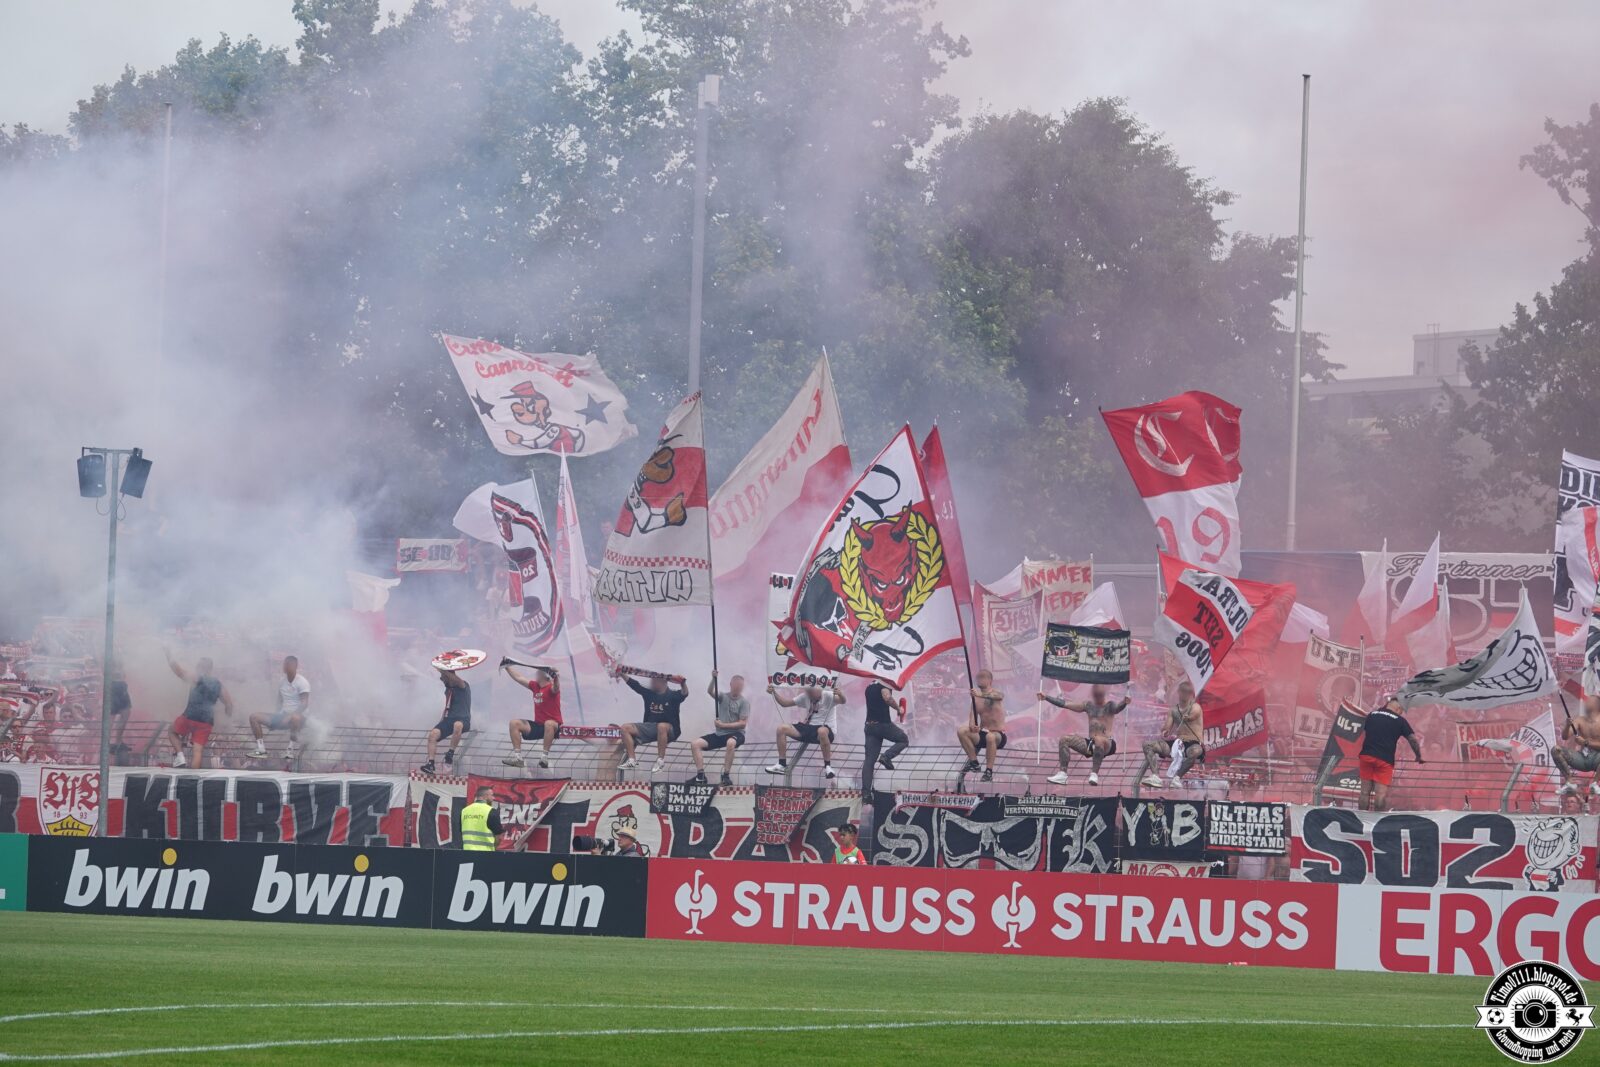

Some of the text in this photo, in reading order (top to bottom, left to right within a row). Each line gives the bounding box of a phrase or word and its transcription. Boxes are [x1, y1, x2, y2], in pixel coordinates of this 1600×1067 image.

[1023, 566, 1091, 592] IMMER
[1046, 658, 1097, 673] SCHWABEN
[1203, 707, 1265, 747] ULTRAS
[669, 785, 714, 795] DU BIST
[765, 788, 813, 799] JEDER
[53, 811, 88, 821] 18 93
[122, 773, 395, 848] KURVE
[667, 804, 685, 813] BEI
[1053, 807, 1078, 816] ULTRAS
[1210, 804, 1284, 824] ULTRAS
[1210, 820, 1284, 837] BEDEUTET
[1209, 833, 1285, 849] WIDERSTAND
[63, 847, 211, 911] bwin
[251, 854, 404, 919] bwin
[447, 862, 605, 929] bwin
[731, 881, 976, 937] STRAUSS
[1050, 892, 1309, 951] STRAUSS
